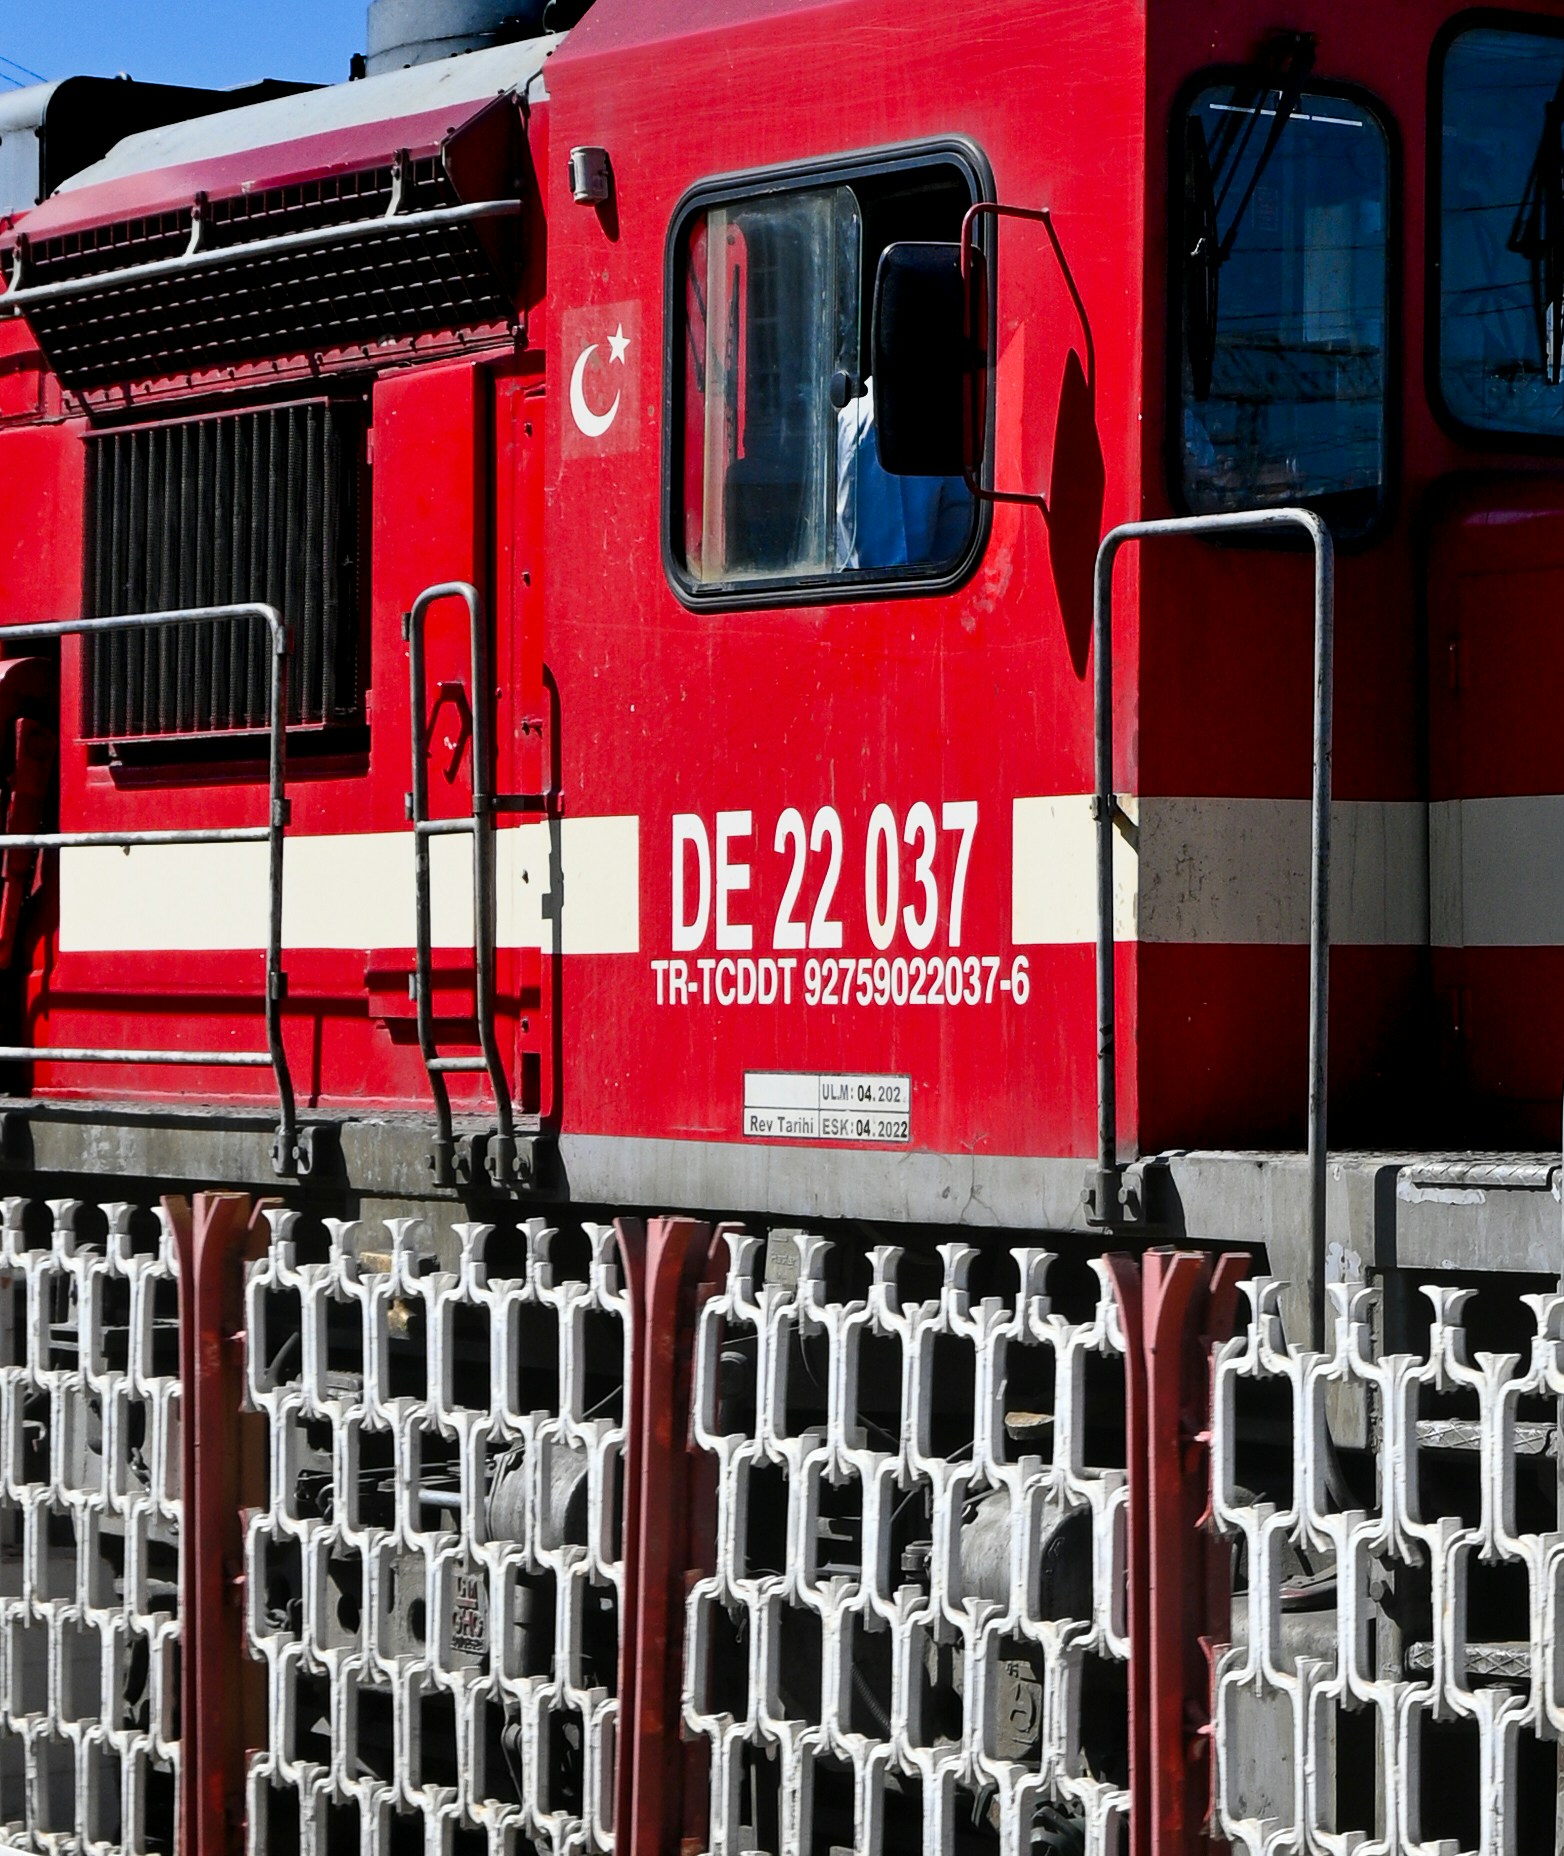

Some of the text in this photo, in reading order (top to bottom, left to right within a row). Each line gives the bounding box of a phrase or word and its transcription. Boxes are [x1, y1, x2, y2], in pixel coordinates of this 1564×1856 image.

[672, 800, 978, 951] DE 22 037
[651, 955, 1030, 1005] TR-TCDDT 92759022037-6
[857, 1084, 907, 1103] 04.202
[750, 1115, 814, 1134] Rev Tarihi
